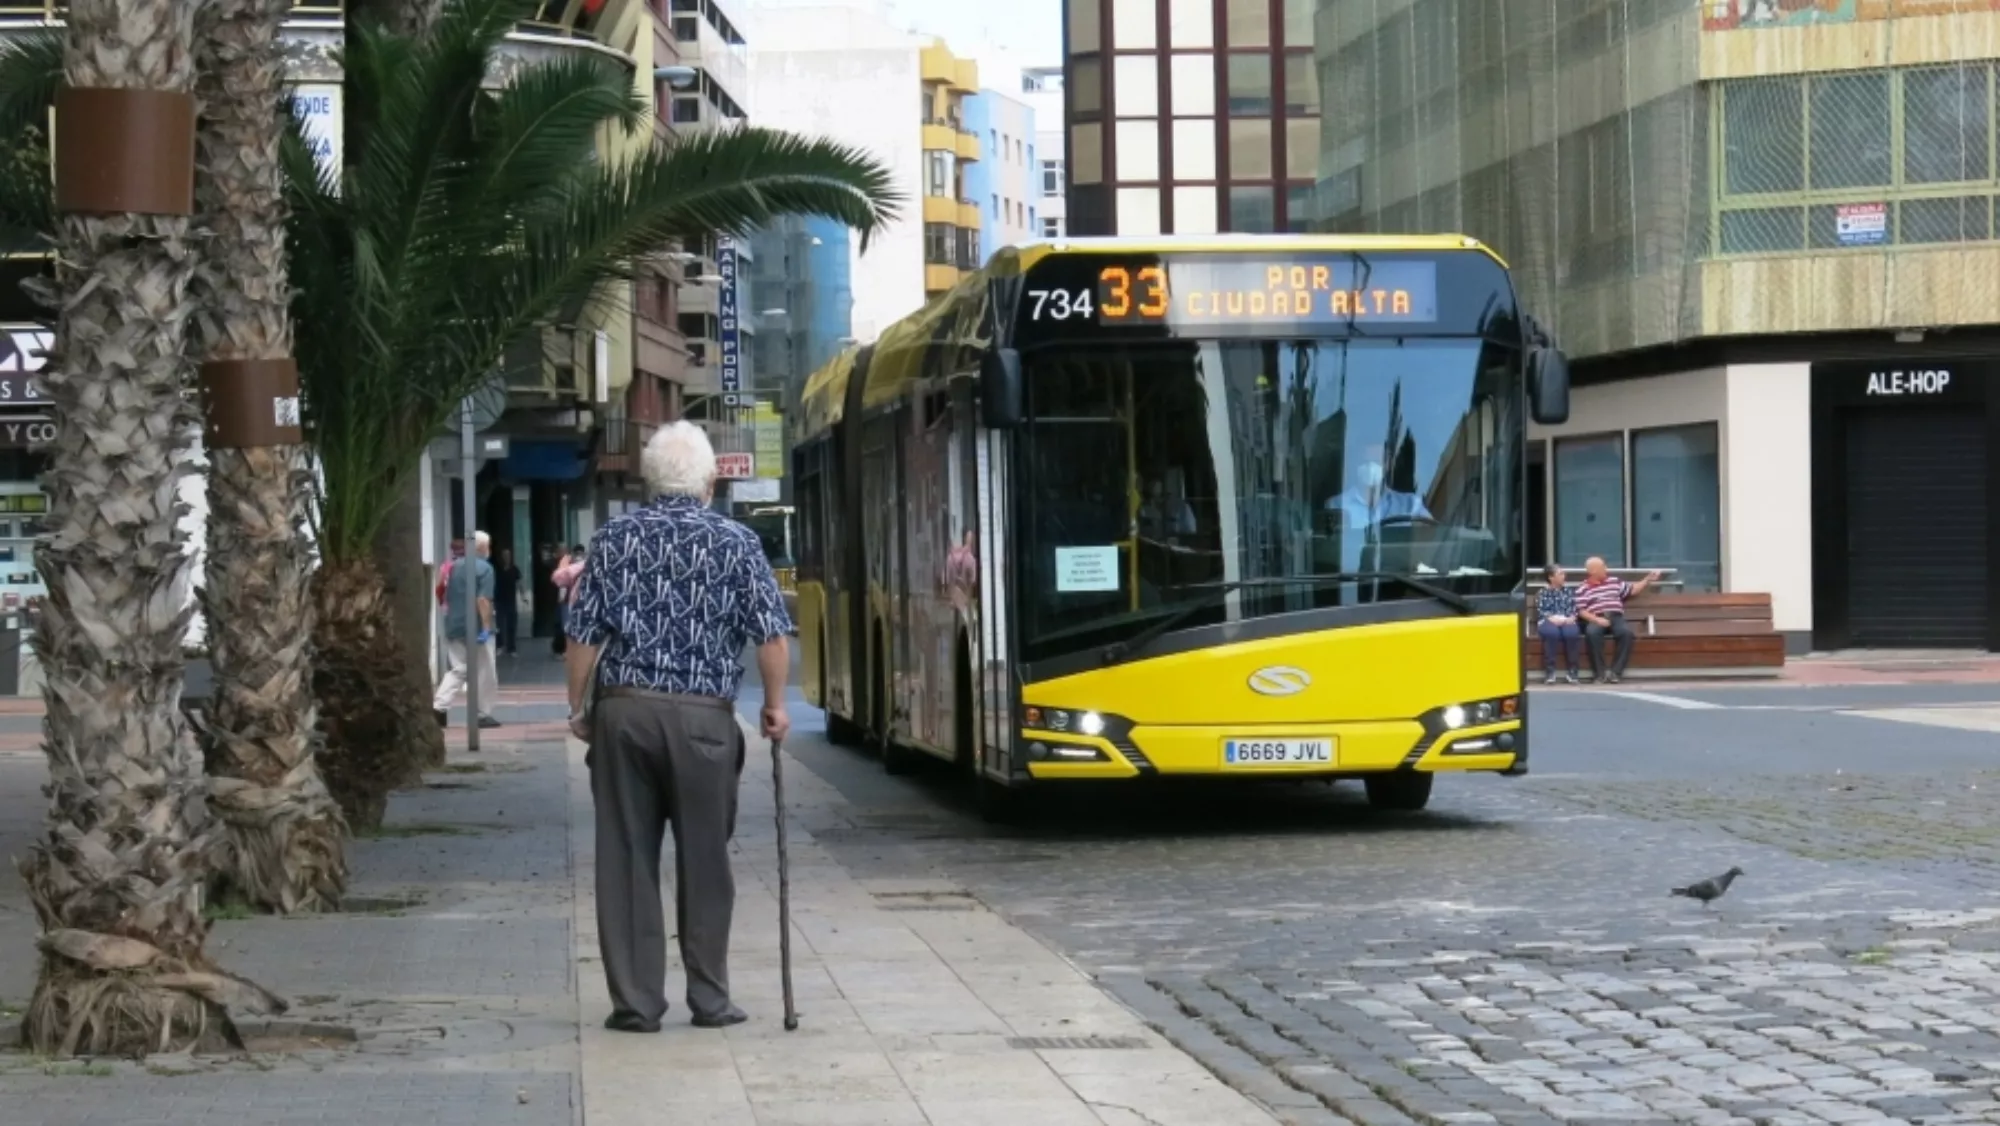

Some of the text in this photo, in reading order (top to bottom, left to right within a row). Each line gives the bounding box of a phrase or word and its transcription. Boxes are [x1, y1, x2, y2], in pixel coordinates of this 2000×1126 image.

[292, 96, 330, 114] ENDE
[1267, 264, 1329, 290] POR
[1028, 288, 1094, 321] 734
[1101, 266, 1168, 317] 33
[1187, 289, 1410, 316] CIUDAD ALTA
[723, 340, 738, 405] PORTO
[1866, 369, 1950, 396] ALE-HOP
[718, 466, 734, 476] 24
[1238, 742, 1328, 760] 6669 JVL
